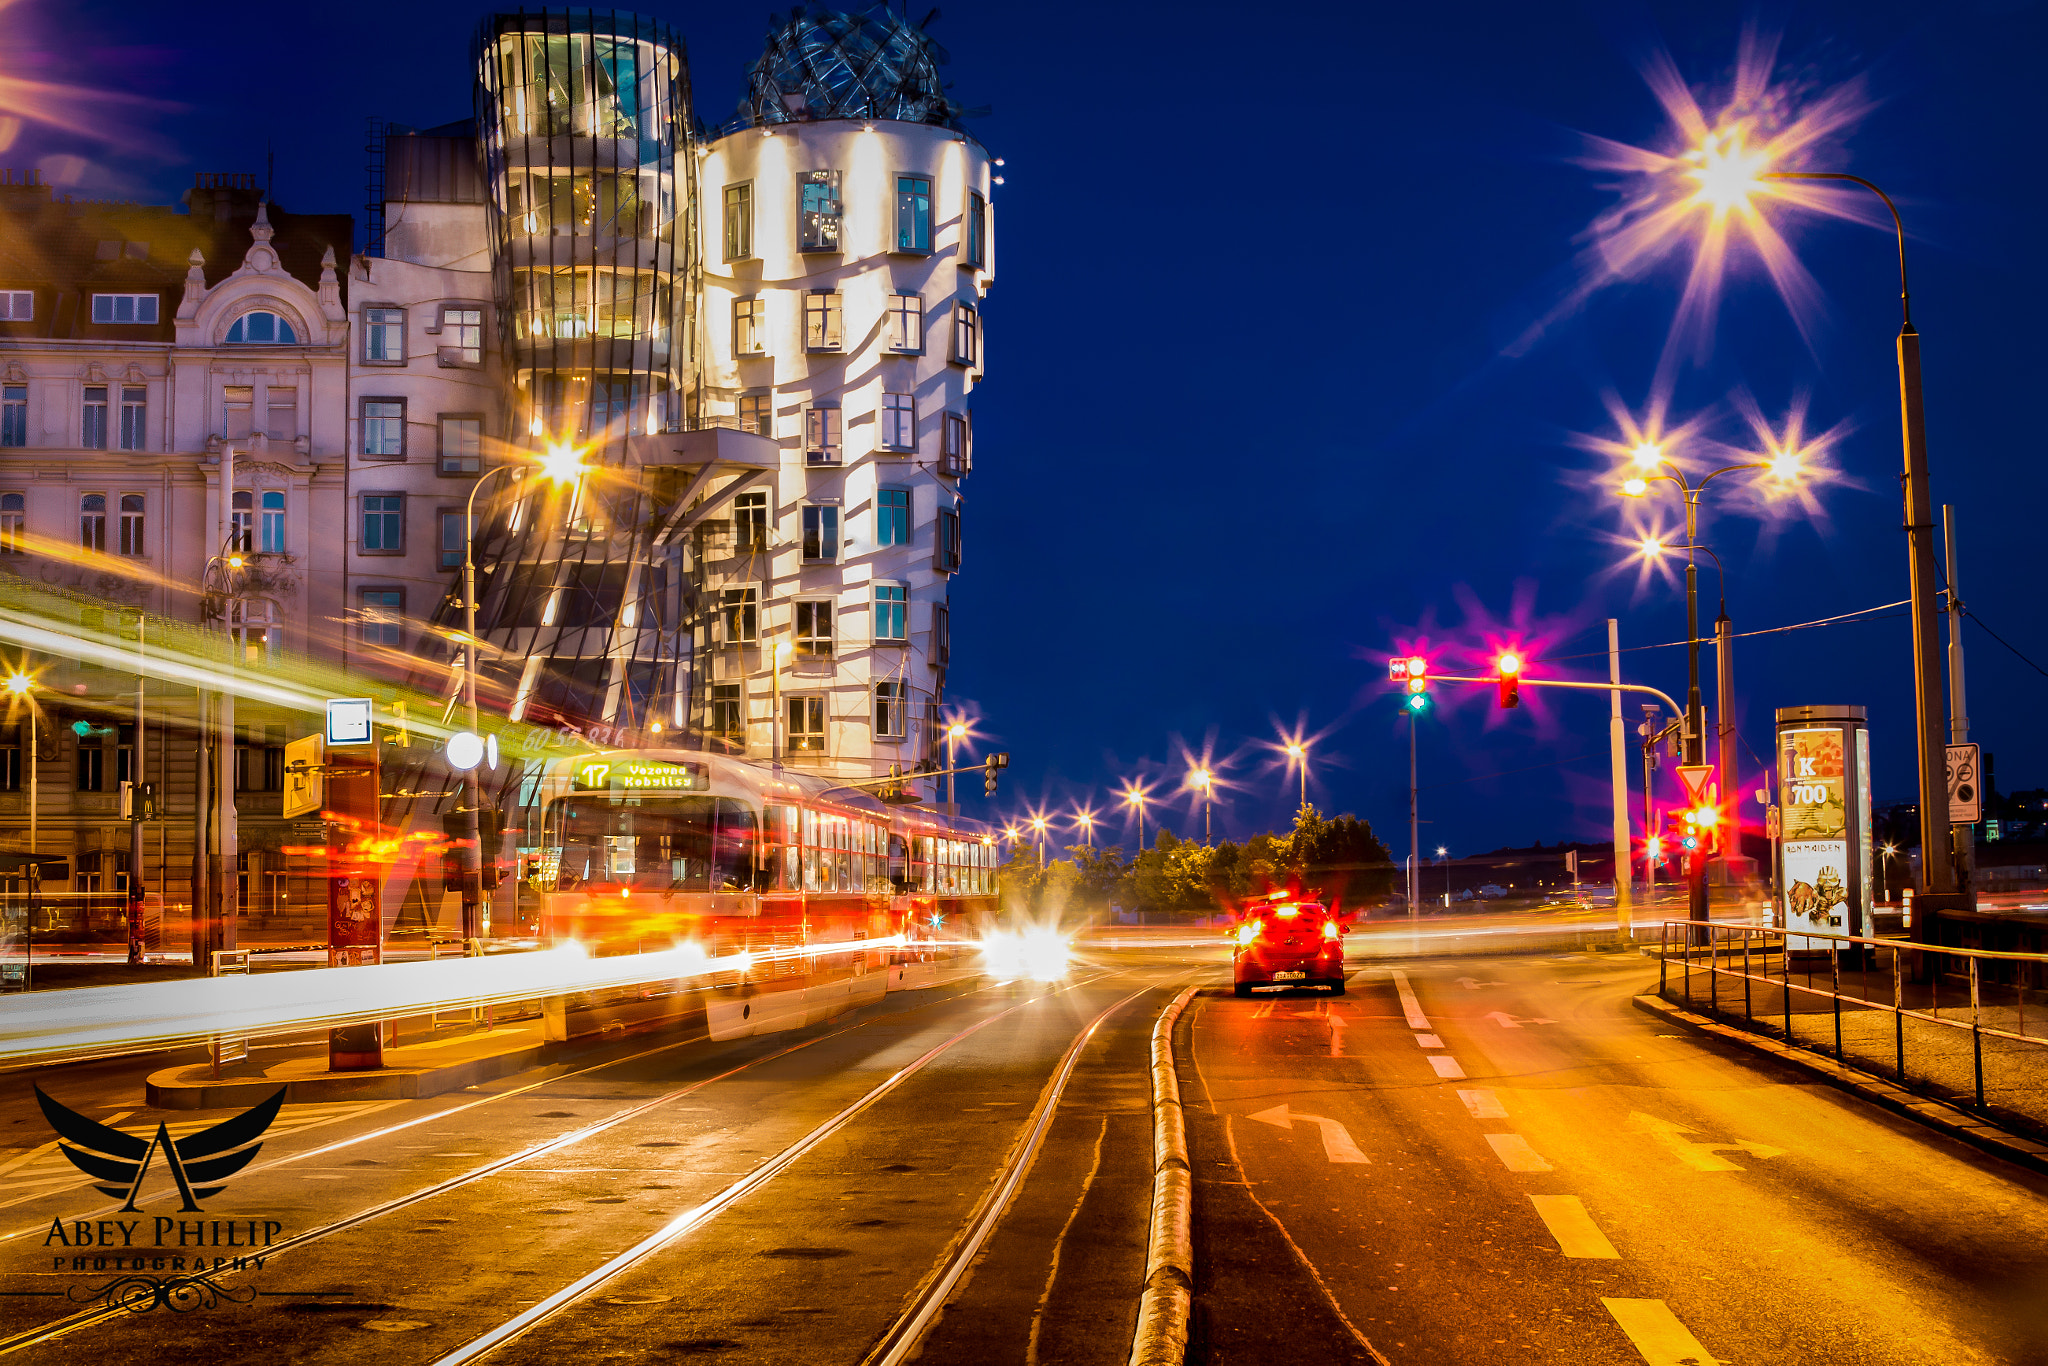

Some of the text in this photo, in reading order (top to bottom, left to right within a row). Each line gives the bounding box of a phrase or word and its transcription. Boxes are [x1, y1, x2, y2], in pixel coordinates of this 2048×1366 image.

[1945, 749, 1971, 762] ÓNA
[629, 765, 687, 775] Vozovna
[1799, 757, 1817, 776] K
[581, 764, 610, 787] 17
[624, 777, 692, 787] Kobylisy
[1791, 784, 1827, 805] 700
